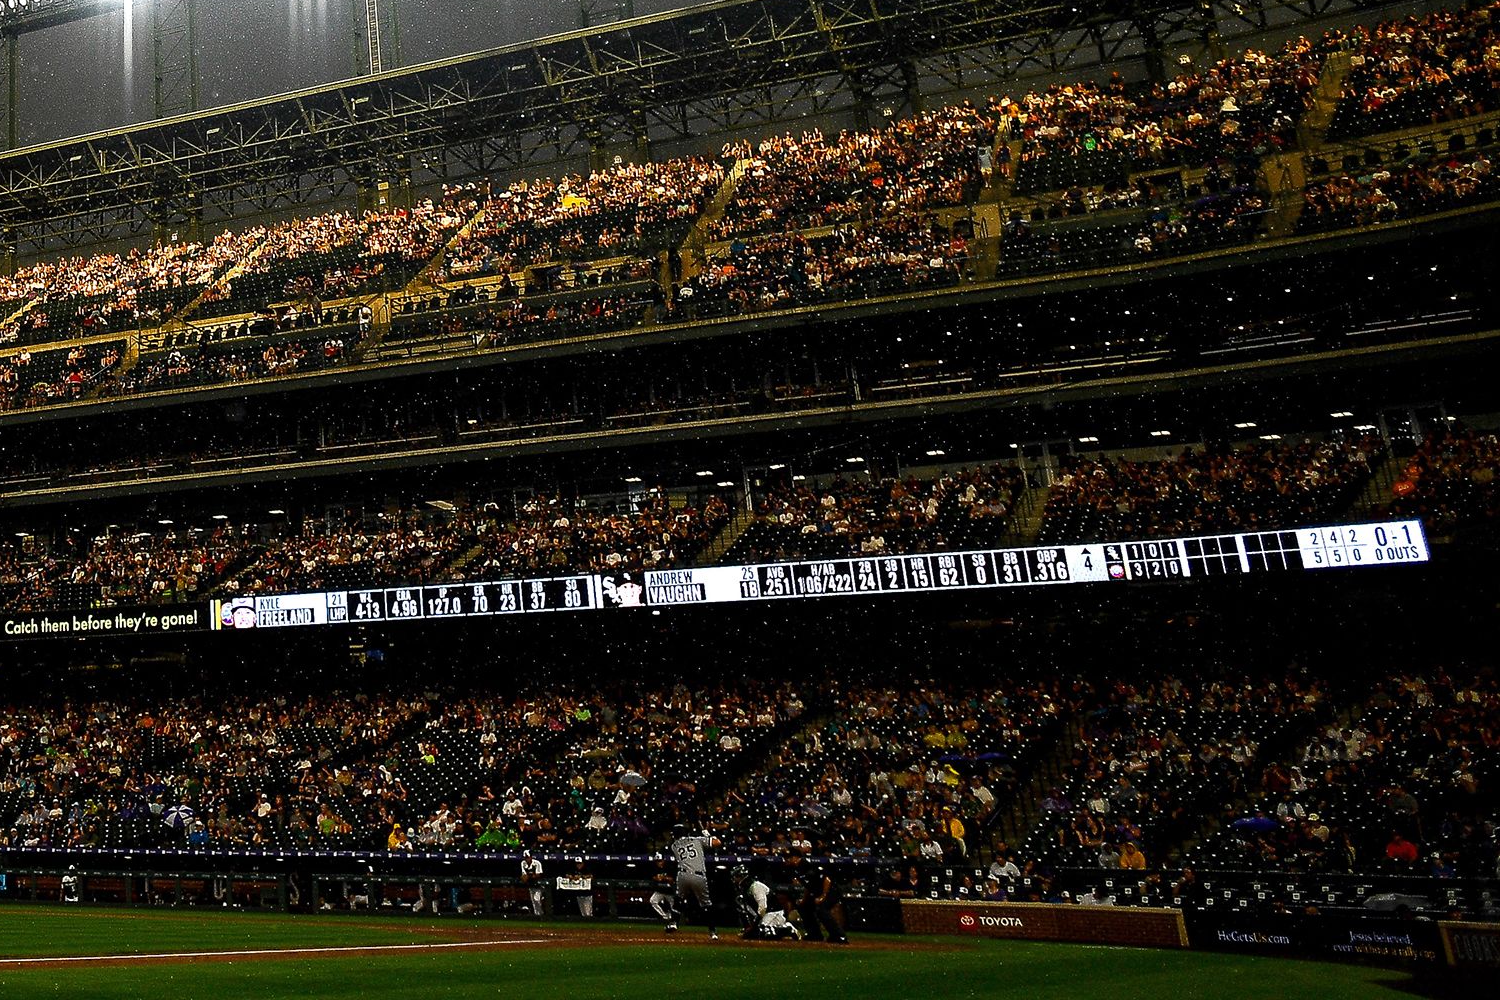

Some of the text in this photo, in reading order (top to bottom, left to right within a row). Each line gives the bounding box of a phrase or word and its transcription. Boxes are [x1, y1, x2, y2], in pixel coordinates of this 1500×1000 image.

[1310, 532, 1319, 545] 2
[1330, 531, 1338, 544] 4
[1349, 529, 1358, 543] 2
[1036, 550, 1058, 563] OBP
[1131, 544, 1139, 559] 1
[1148, 543, 1157, 558] 0
[1166, 542, 1174, 557] 1
[1333, 550, 1342, 563] 5
[1353, 548, 1362, 562] 0
[1375, 545, 1420, 561] 0 OUTS
[910, 557, 924, 570] HR
[938, 555, 956, 569] RBI
[972, 554, 986, 567] SB
[1003, 552, 1018, 565] BB
[1084, 555, 1093, 572] 4
[1314, 551, 1323, 564] 5
[766, 566, 785, 579] AVG
[810, 563, 836, 577] H/AB
[858, 560, 872, 573] 2B
[884, 559, 898, 572] 3B
[1004, 564, 1022, 582] 31
[1034, 561, 1068, 581] .316
[1133, 562, 1143, 577] 3
[1152, 561, 1161, 576] 2
[1169, 560, 1179, 575] 0
[649, 571, 693, 586] ANDREW
[741, 567, 754, 580] 25
[858, 572, 876, 590] 24
[888, 572, 899, 589] 2
[911, 569, 929, 587] 15
[940, 567, 959, 586] 62
[976, 566, 987, 584] 0
[473, 585, 485, 596] ER
[501, 583, 513, 595] HR
[531, 581, 544, 593] BB
[565, 579, 577, 591] SO
[741, 581, 757, 598] 1B
[763, 577, 791, 597] .251
[797, 574, 851, 594] 106/422
[331, 594, 342, 605] 21
[395, 589, 412, 601] ERA
[438, 588, 448, 599] IP
[530, 592, 546, 610] 37
[564, 590, 581, 607] 80
[650, 584, 701, 603] VAUGHN
[259, 597, 280, 610] KYLE
[355, 601, 381, 619] 4-13
[391, 599, 418, 618] 4.96
[428, 597, 462, 615] 127.0
[472, 596, 489, 613] 70
[500, 594, 517, 611] 23
[258, 608, 312, 626] FREELAND
[329, 607, 346, 621] LHP
[4, 609, 198, 635] Catch them before they're gone!
[678, 843, 697, 861] 25
[979, 915, 1023, 928] TOYOTA
[1217, 930, 1290, 945] HeGetsUs.com
